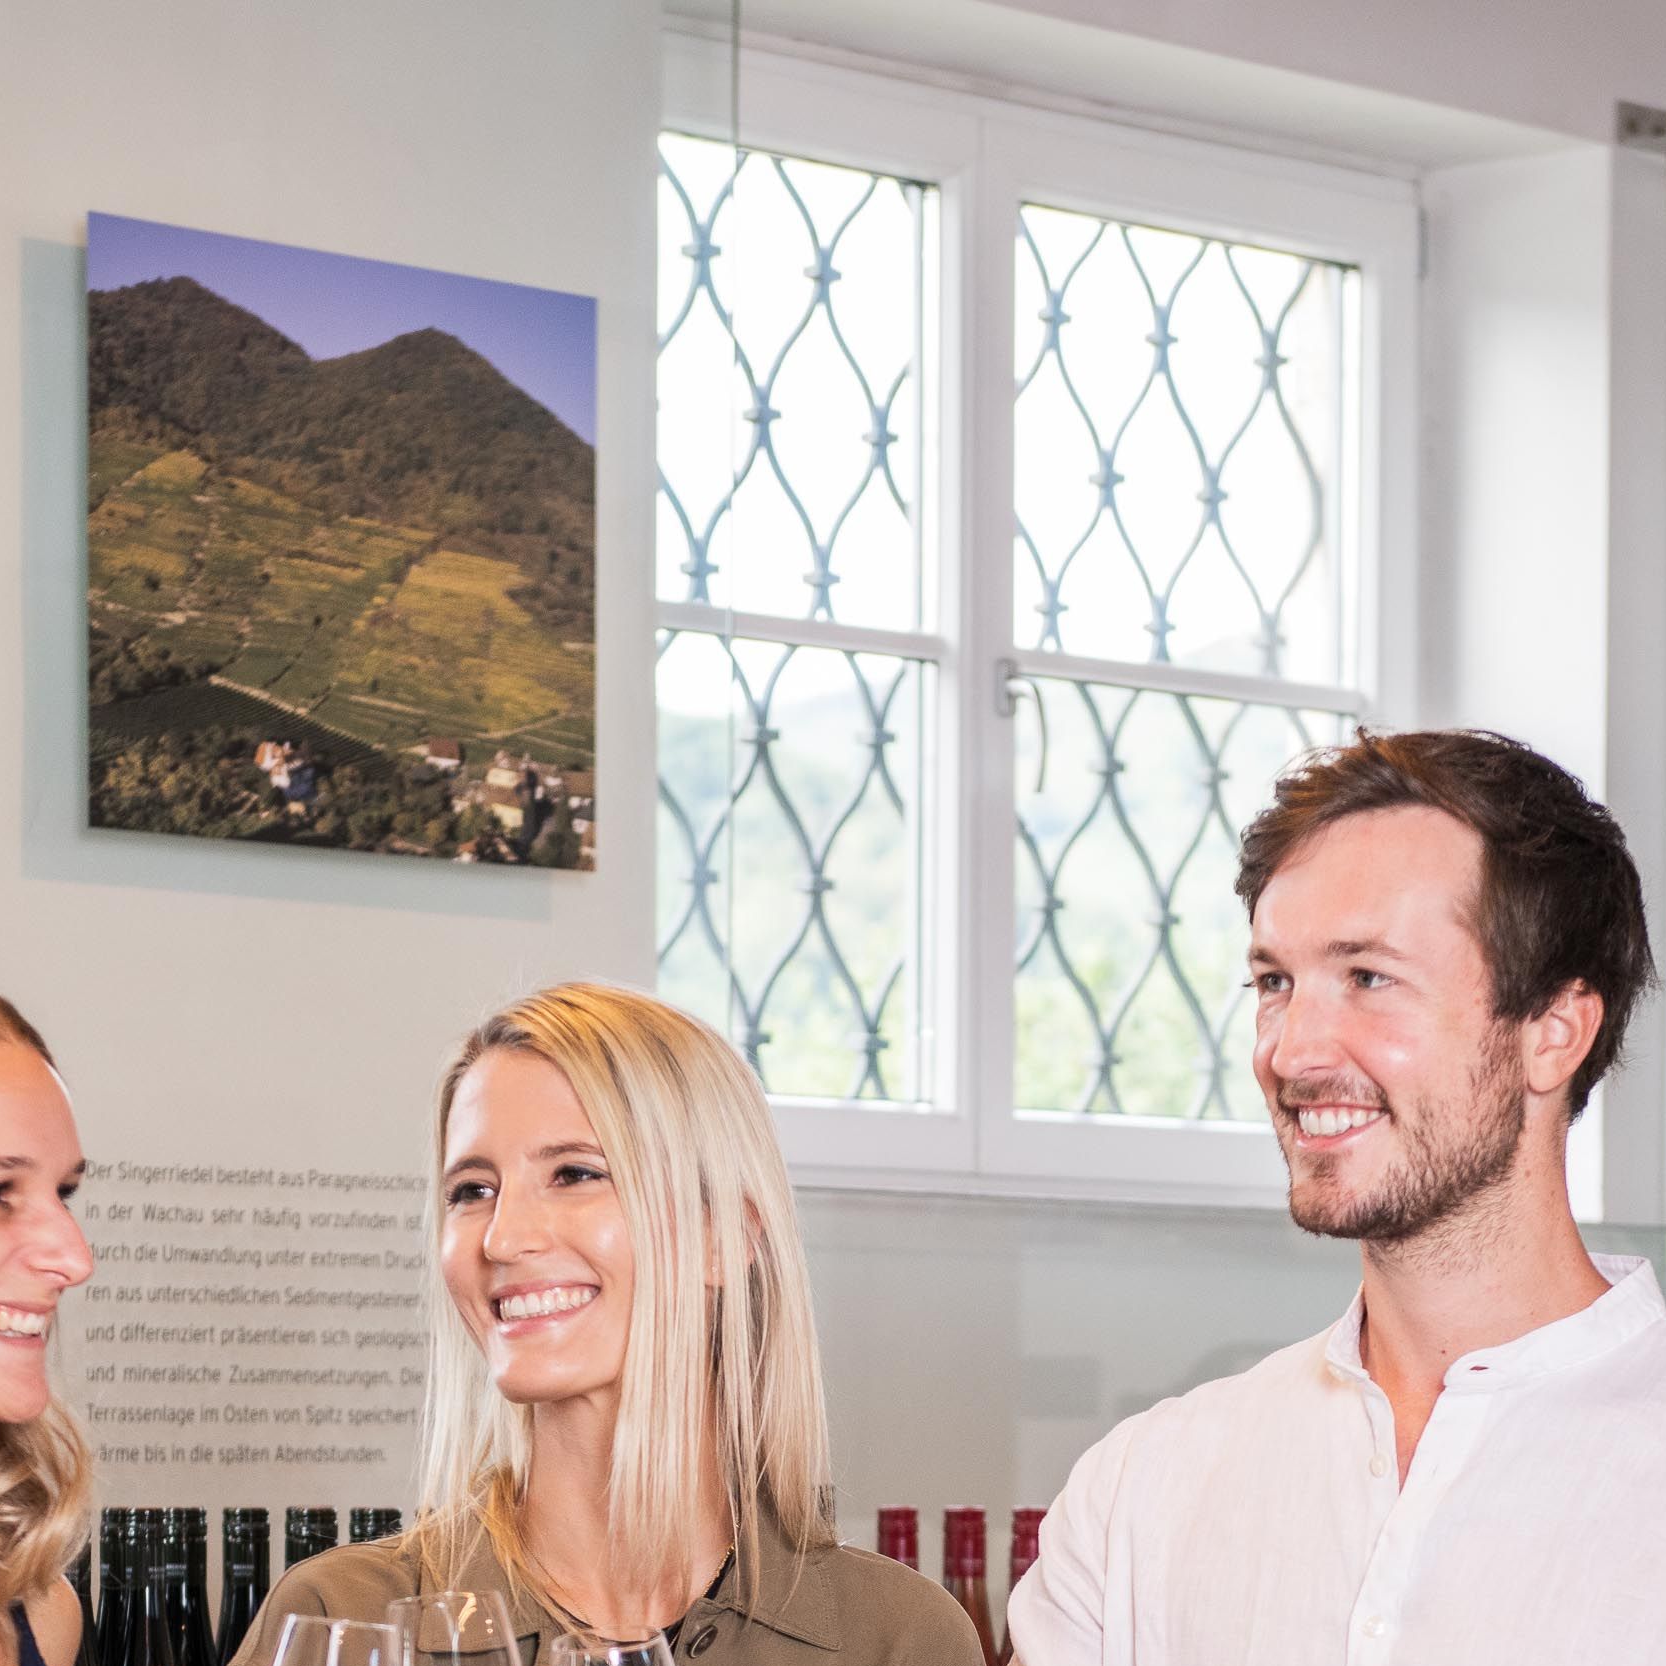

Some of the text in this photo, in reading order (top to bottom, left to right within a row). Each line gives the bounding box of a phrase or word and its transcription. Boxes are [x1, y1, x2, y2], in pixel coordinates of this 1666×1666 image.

[85, 1160, 113, 1180] Der
[118, 1162, 213, 1187] Singerriedel
[217, 1167, 273, 1186] besteht
[278, 1172, 305, 1187] aus
[85, 1202, 100, 1220] in
[107, 1203, 133, 1221] der
[142, 1205, 204, 1224] Wachau
[212, 1208, 244, 1224] sehr
[252, 1209, 301, 1231] häufig
[309, 1211, 398, 1229] vorzufinden
[135, 1245, 158, 1263] die
[163, 1246, 261, 1269] Umwandlung
[265, 1250, 305, 1267] unter
[310, 1251, 380, 1268] extremen
[85, 1286, 111, 1301] ren
[116, 1287, 142, 1302] aus
[147, 1286, 281, 1306] unterschiedlichen
[85, 1324, 115, 1343] und
[120, 1323, 215, 1344] differenziert
[220, 1327, 316, 1347] präsentieren
[321, 1330, 350, 1347] sich
[85, 1364, 115, 1384] und
[123, 1364, 222, 1384] mineralische
[400, 1368, 425, 1388] Die
[86, 1403, 195, 1426] Terrassenlage
[199, 1404, 220, 1423] im
[223, 1404, 269, 1424] Osten
[273, 1408, 301, 1425] von
[305, 1405, 343, 1427] Spitz
[95, 1444, 135, 1462] ärme
[144, 1443, 166, 1462] bis
[171, 1444, 185, 1462] in
[190, 1444, 214, 1463] die
[218, 1445, 270, 1466] späten
